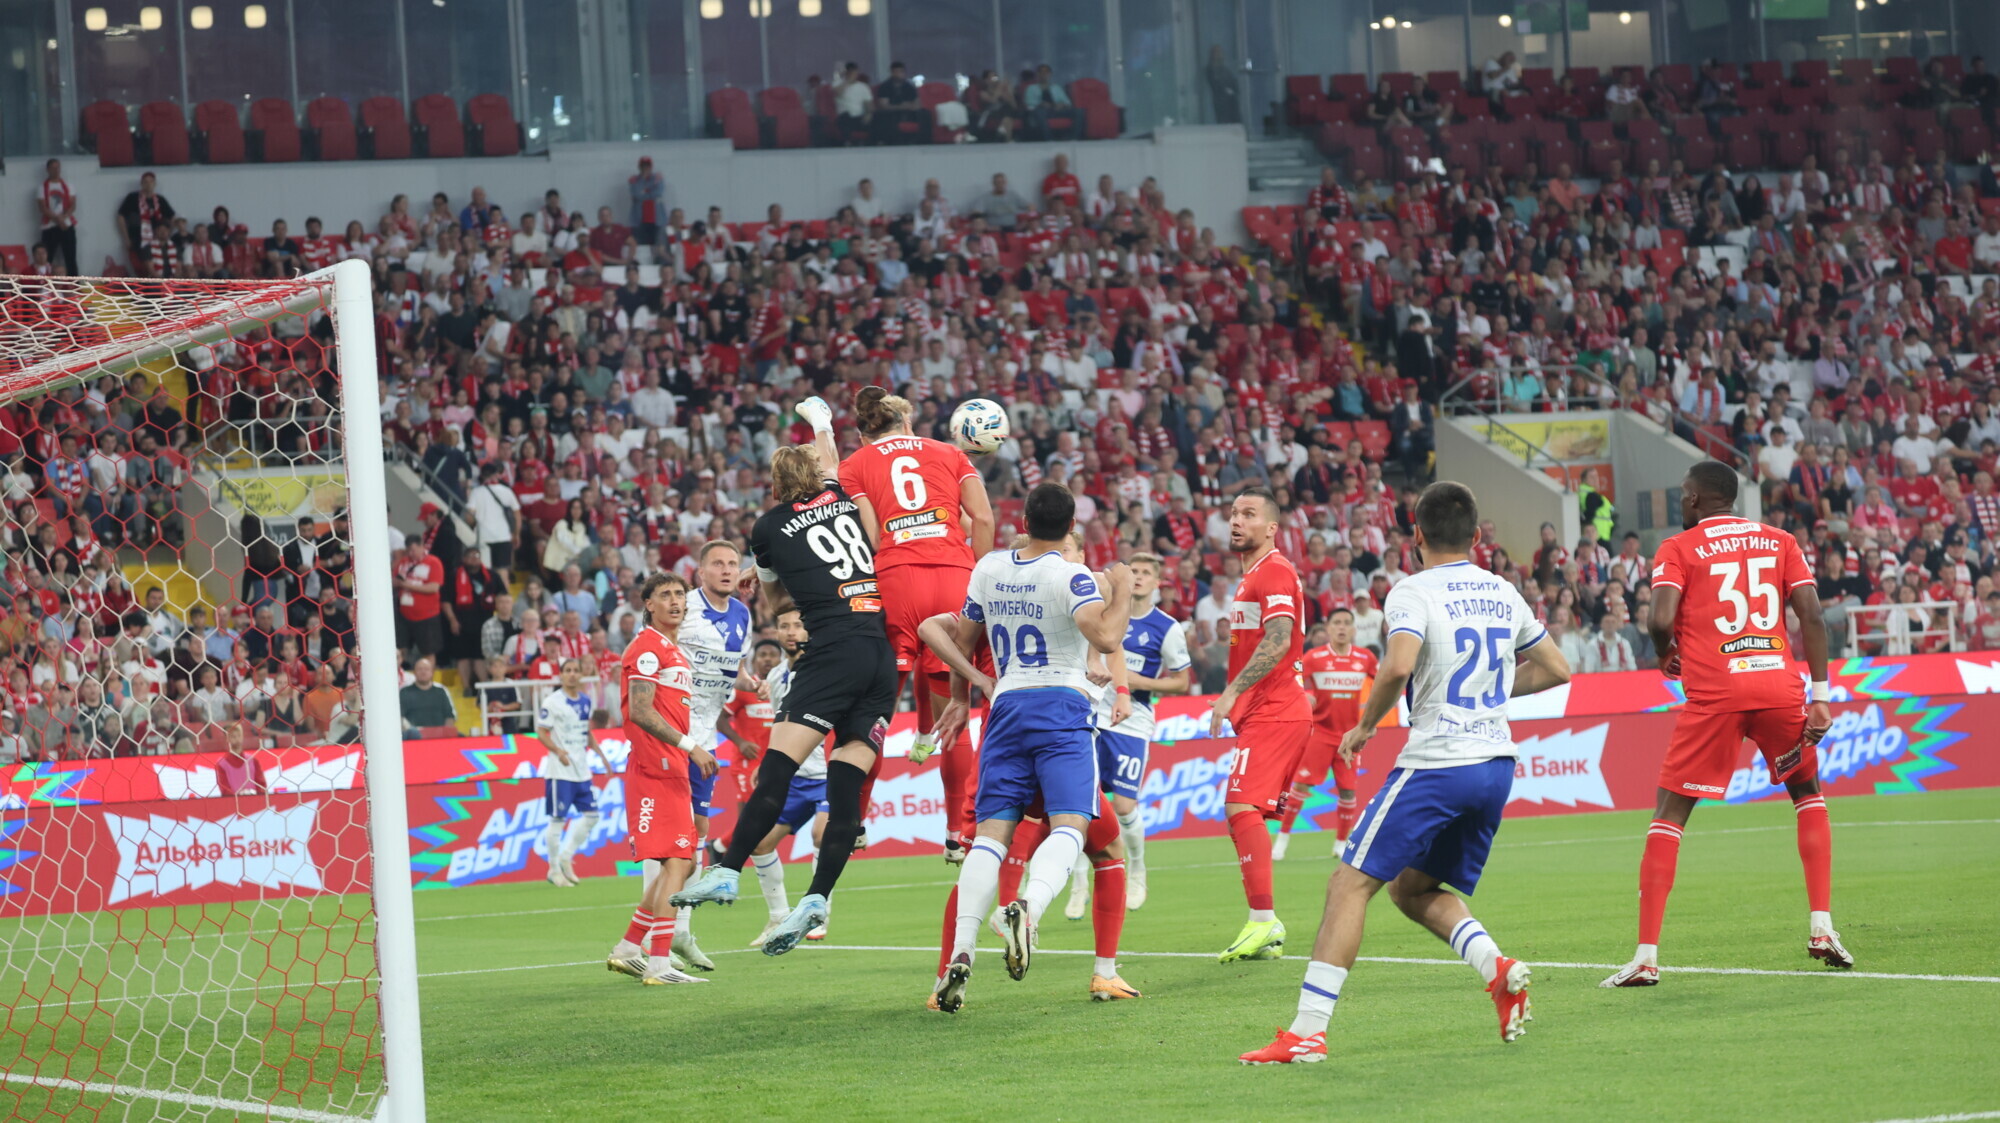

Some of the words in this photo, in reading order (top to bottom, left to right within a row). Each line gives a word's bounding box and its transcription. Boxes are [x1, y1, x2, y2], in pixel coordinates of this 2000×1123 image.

[877, 440, 923, 456] БАБИЧ
[890, 456, 927, 511] 6
[888, 511, 935, 532] WINLINE
[806, 514, 874, 580] 98
[1695, 535, 1780, 560] К.МАРТИНС
[843, 582, 877, 597] WINLINE
[995, 582, 1036, 594] БЕТСИТИ
[1447, 582, 1500, 592] БЕТСИТИ
[1710, 556, 1779, 635] 35
[1444, 599, 1513, 622] АГАЛАРОВ
[991, 624, 1049, 680] 99
[1724, 638, 1771, 653] WINLINE
[709, 655, 740, 666] МАГНИ
[1447, 627, 1511, 710] 25
[1117, 754, 1141, 780] 70
[1531, 756, 1589, 777] Банк
[1682, 782, 1726, 794] GENESIS
[902, 794, 946, 816] Бан
[134, 837, 222, 874] Альфа
[229, 836, 295, 858] Банк
